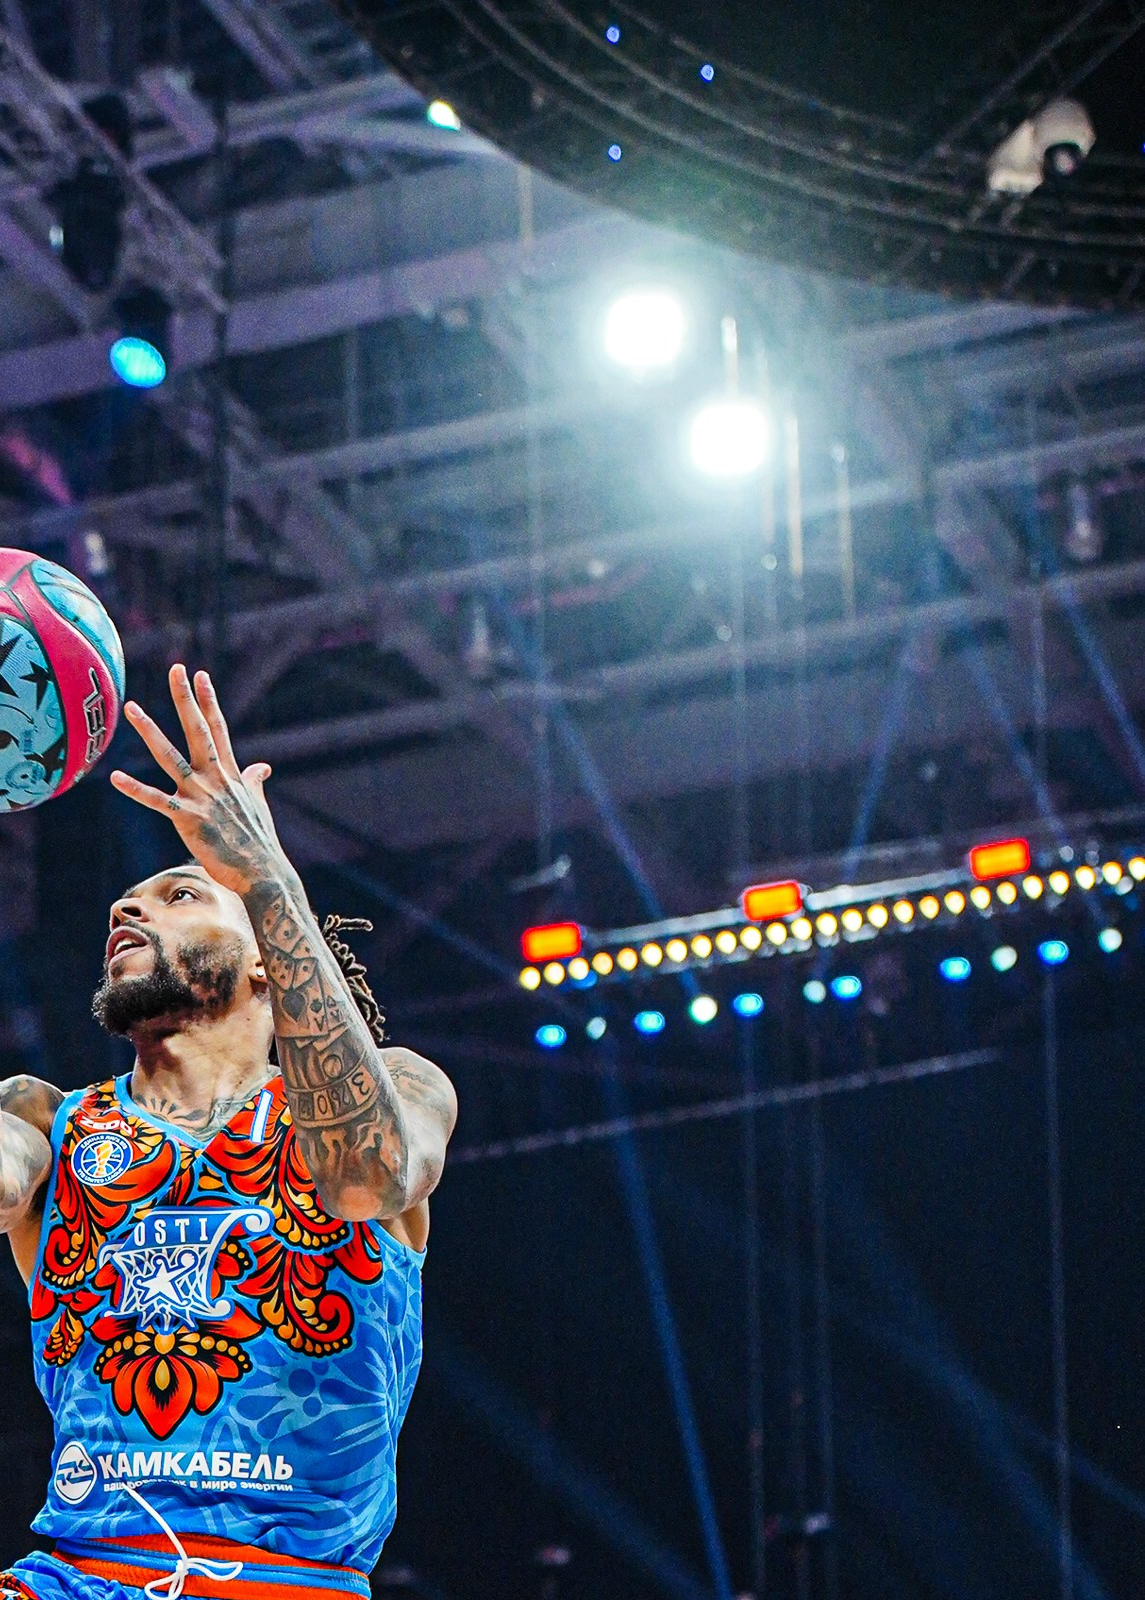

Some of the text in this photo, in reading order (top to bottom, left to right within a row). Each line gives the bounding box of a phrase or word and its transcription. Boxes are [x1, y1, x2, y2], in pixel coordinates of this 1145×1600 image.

[97, 1451, 294, 1481] КАМКАБЕЛЬ
[201, 1480, 237, 1492] мире
[239, 1481, 294, 1492] энергии
